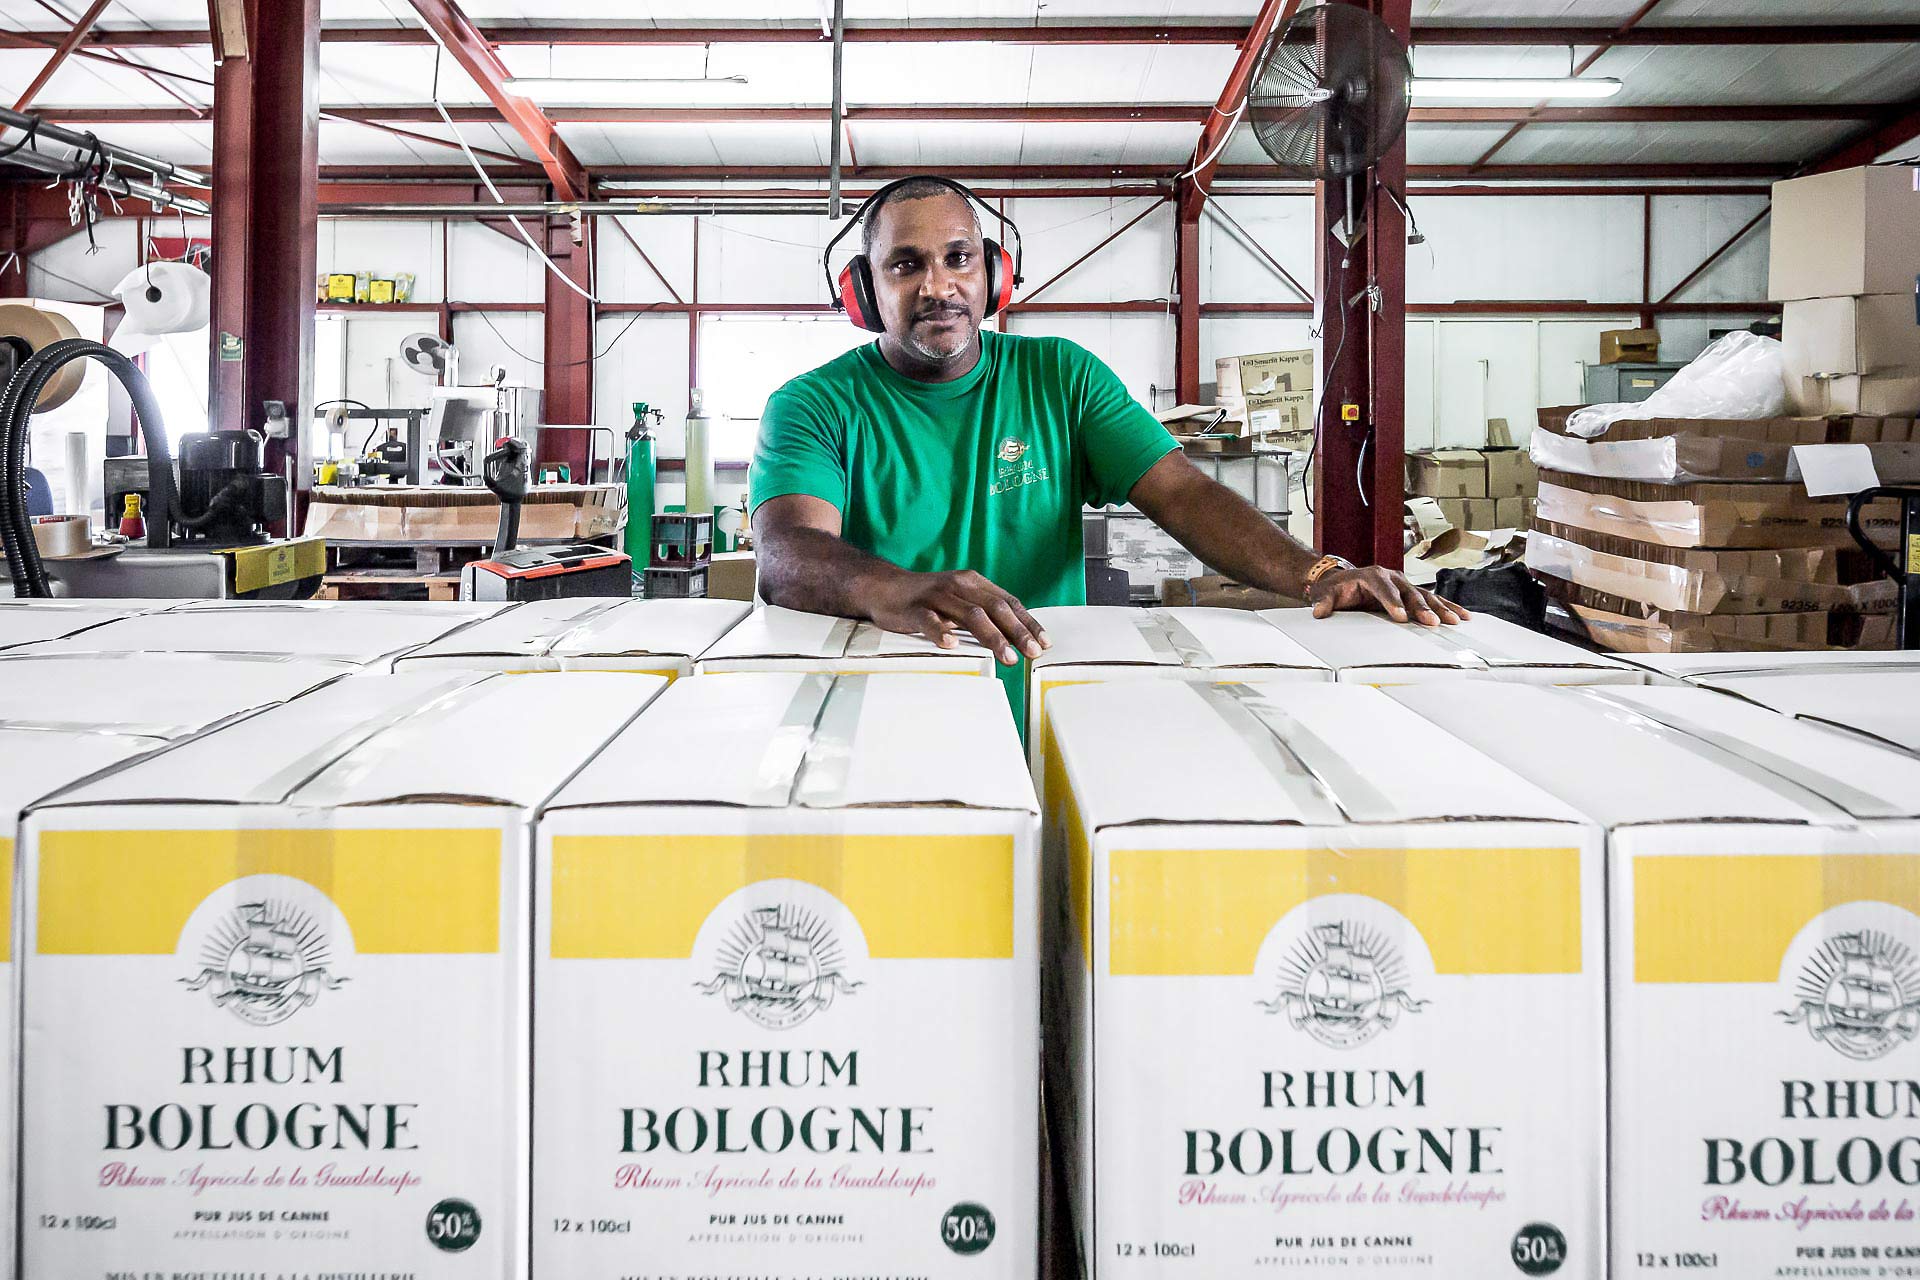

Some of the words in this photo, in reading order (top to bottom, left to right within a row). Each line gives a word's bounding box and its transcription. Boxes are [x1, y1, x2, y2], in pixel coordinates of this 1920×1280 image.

[1279, 355, 1299, 364] Kappa
[1284, 395, 1304, 403] Kappa
[990, 467, 1050, 496] BOLOGNE
[1781, 600, 1820, 611] 92356
[180, 1047, 344, 1084] RHUM
[698, 1050, 858, 1087] RHUM
[1261, 1070, 1427, 1108] RHUM
[103, 1102, 418, 1151] BOLOGNE
[619, 1107, 935, 1154] BOLOGNE
[1184, 1127, 1504, 1175] BOLOGNE
[1703, 1136, 1920, 1186] BOLOG
[98, 1161, 166, 1188] Rhum
[172, 1162, 259, 1197] Agricole
[263, 1166, 284, 1187] de
[289, 1166, 308, 1187] la
[314, 1162, 422, 1197] Guadeloupe
[613, 1163, 683, 1190] Rhum
[687, 1164, 775, 1198] Agricole
[779, 1167, 799, 1189] de
[804, 1167, 823, 1189] la
[829, 1164, 937, 1198] Guadeloupe
[1178, 1179, 1247, 1205] Rhum
[1252, 1180, 1342, 1214] Agricole
[1346, 1182, 1368, 1205] de
[1372, 1181, 1392, 1205] la
[1398, 1178, 1508, 1212] Guadeloupe
[194, 1210, 222, 1223] PUR
[227, 1210, 254, 1223] JUS
[258, 1210, 275, 1222] DE
[281, 1210, 330, 1222] CANNE
[709, 1214, 737, 1226] PUR
[743, 1214, 768, 1226] JUS
[773, 1214, 789, 1226] DE
[796, 1214, 845, 1226] CANNE
[1702, 1195, 1770, 1221] Rhum
[1775, 1195, 1864, 1232] Agricole
[1868, 1198, 1890, 1221] de
[1895, 1198, 1915, 1221] la
[40, 1214, 57, 1229] 12
[76, 1214, 117, 1231] 100cl
[553, 1218, 571, 1233] 12
[575, 1221, 585, 1233] x
[590, 1218, 631, 1234] 100cl
[173, 1228, 267, 1241] APPELLATION
[273, 1228, 350, 1241] D'ORIGINE
[688, 1232, 781, 1244] APPELLATION
[788, 1232, 865, 1244] D'ORIGINE
[1276, 1236, 1304, 1248] PUR
[1310, 1236, 1335, 1248] JUS
[1341, 1236, 1356, 1248] DE
[1364, 1235, 1413, 1248] CANNE
[1116, 1242, 1133, 1257] 12
[1137, 1245, 1147, 1257] x
[1153, 1241, 1196, 1258] 100cl
[1796, 1246, 1825, 1259] PUR
[1830, 1246, 1857, 1259] JUS
[1861, 1246, 1879, 1259] DE
[1254, 1255, 1349, 1267] APPELLATION
[1637, 1252, 1655, 1268] 12
[1660, 1255, 1670, 1268] x
[1674, 1252, 1719, 1268] 100cl
[1774, 1265, 1872, 1278] APPELLATION
